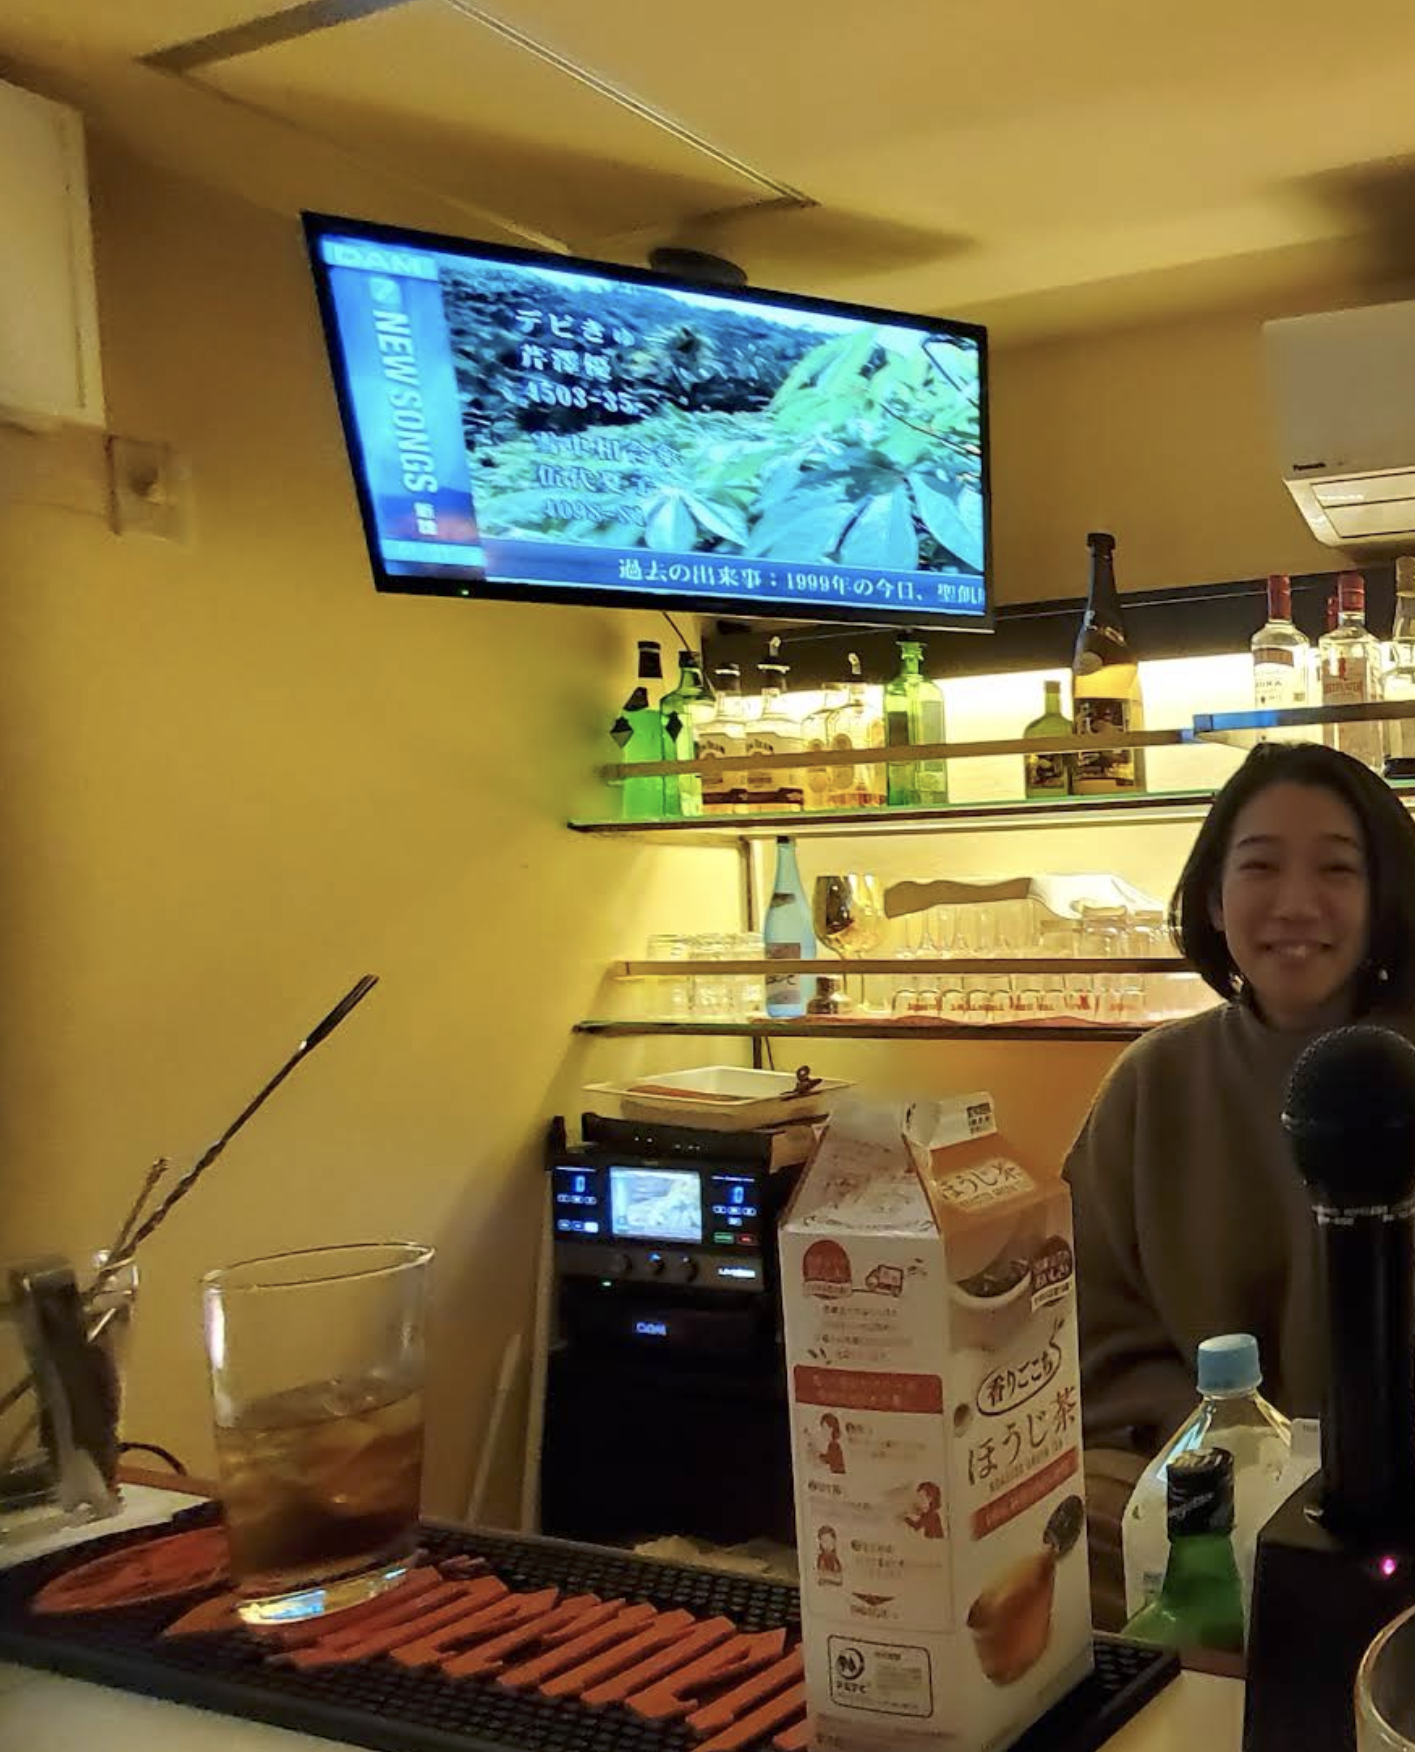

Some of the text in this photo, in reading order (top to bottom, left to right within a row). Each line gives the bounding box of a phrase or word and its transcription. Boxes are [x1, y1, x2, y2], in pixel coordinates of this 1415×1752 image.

[372, 309, 420, 387] NEW
[390, 389, 438, 494] SONGS
[968, 1386, 1076, 1486] ほうじ茶
